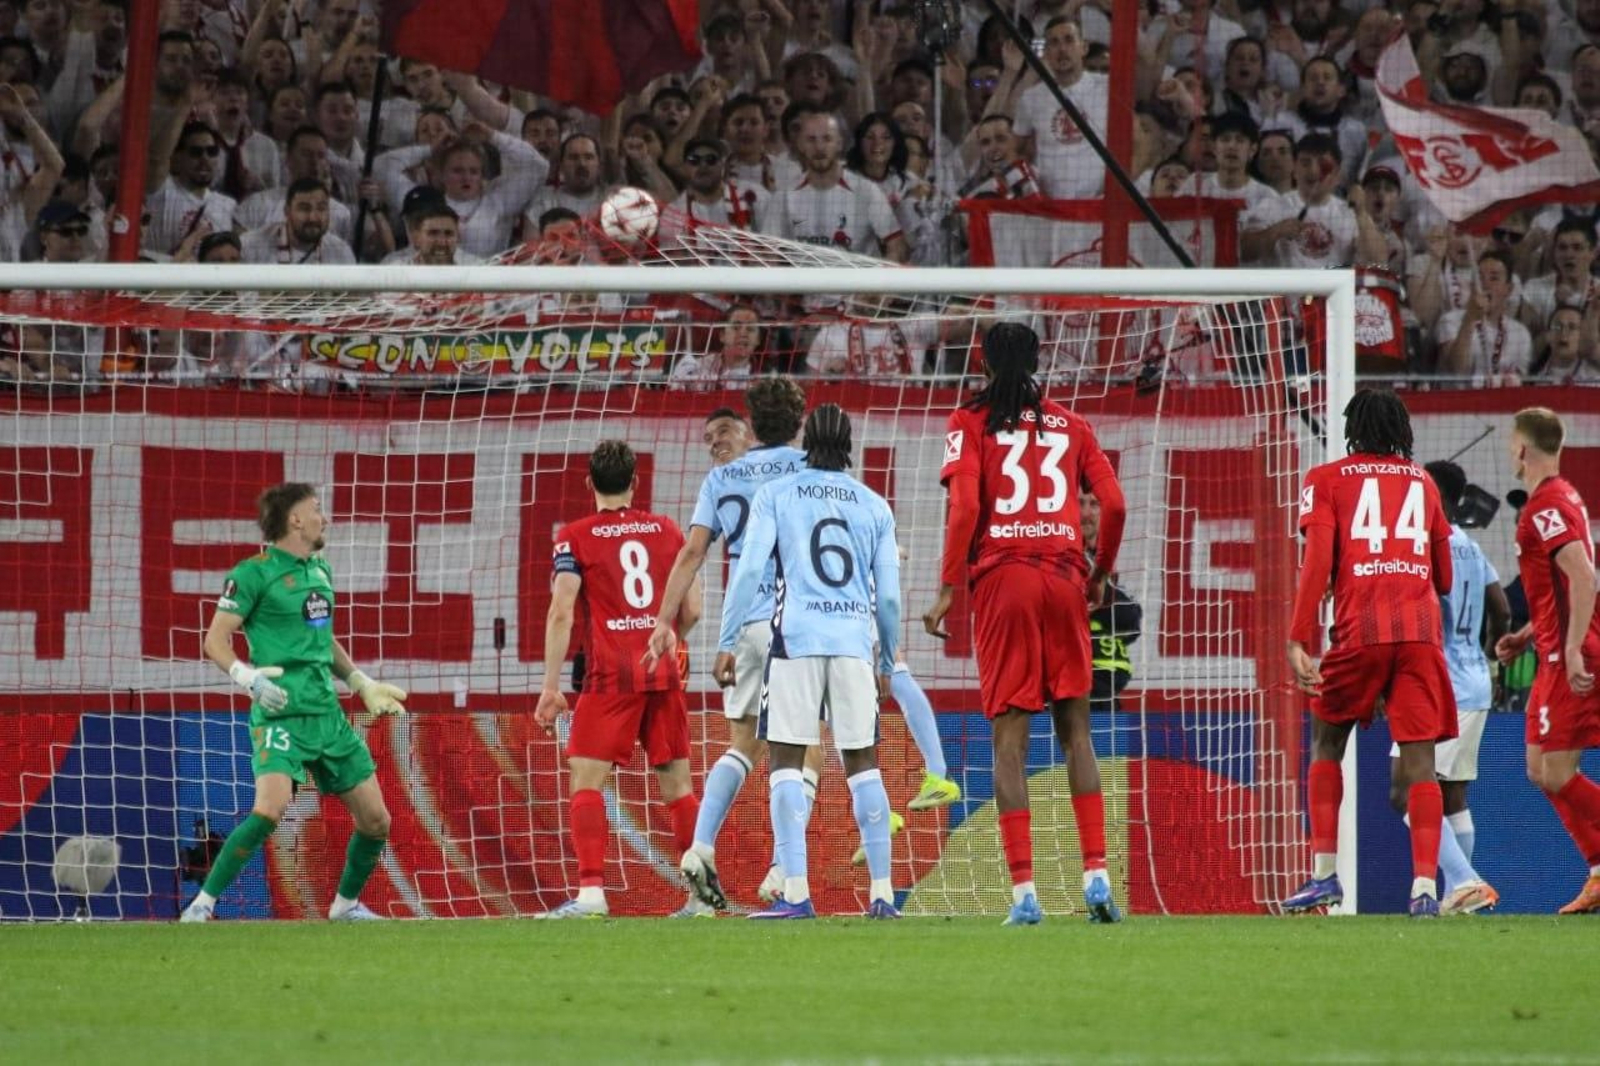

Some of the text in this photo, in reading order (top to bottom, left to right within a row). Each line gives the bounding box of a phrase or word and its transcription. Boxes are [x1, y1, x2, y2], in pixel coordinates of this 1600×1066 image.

[504, 330, 658, 373] VOLTS
[722, 461, 782, 480] MARCOS
[995, 430, 1069, 514] 33
[797, 485, 859, 504] MORIBA
[591, 521, 662, 538] eggestein
[1351, 478, 1429, 556] 44
[989, 521, 1076, 541] scfreiburg
[810, 517, 854, 588] 6
[619, 540, 654, 609] 8
[1353, 559, 1429, 580] scfreiburg
[606, 615, 658, 631] scfreib
[1455, 580, 1472, 646] 4
[1539, 706, 1551, 735] 3
[265, 726, 291, 751] 13
